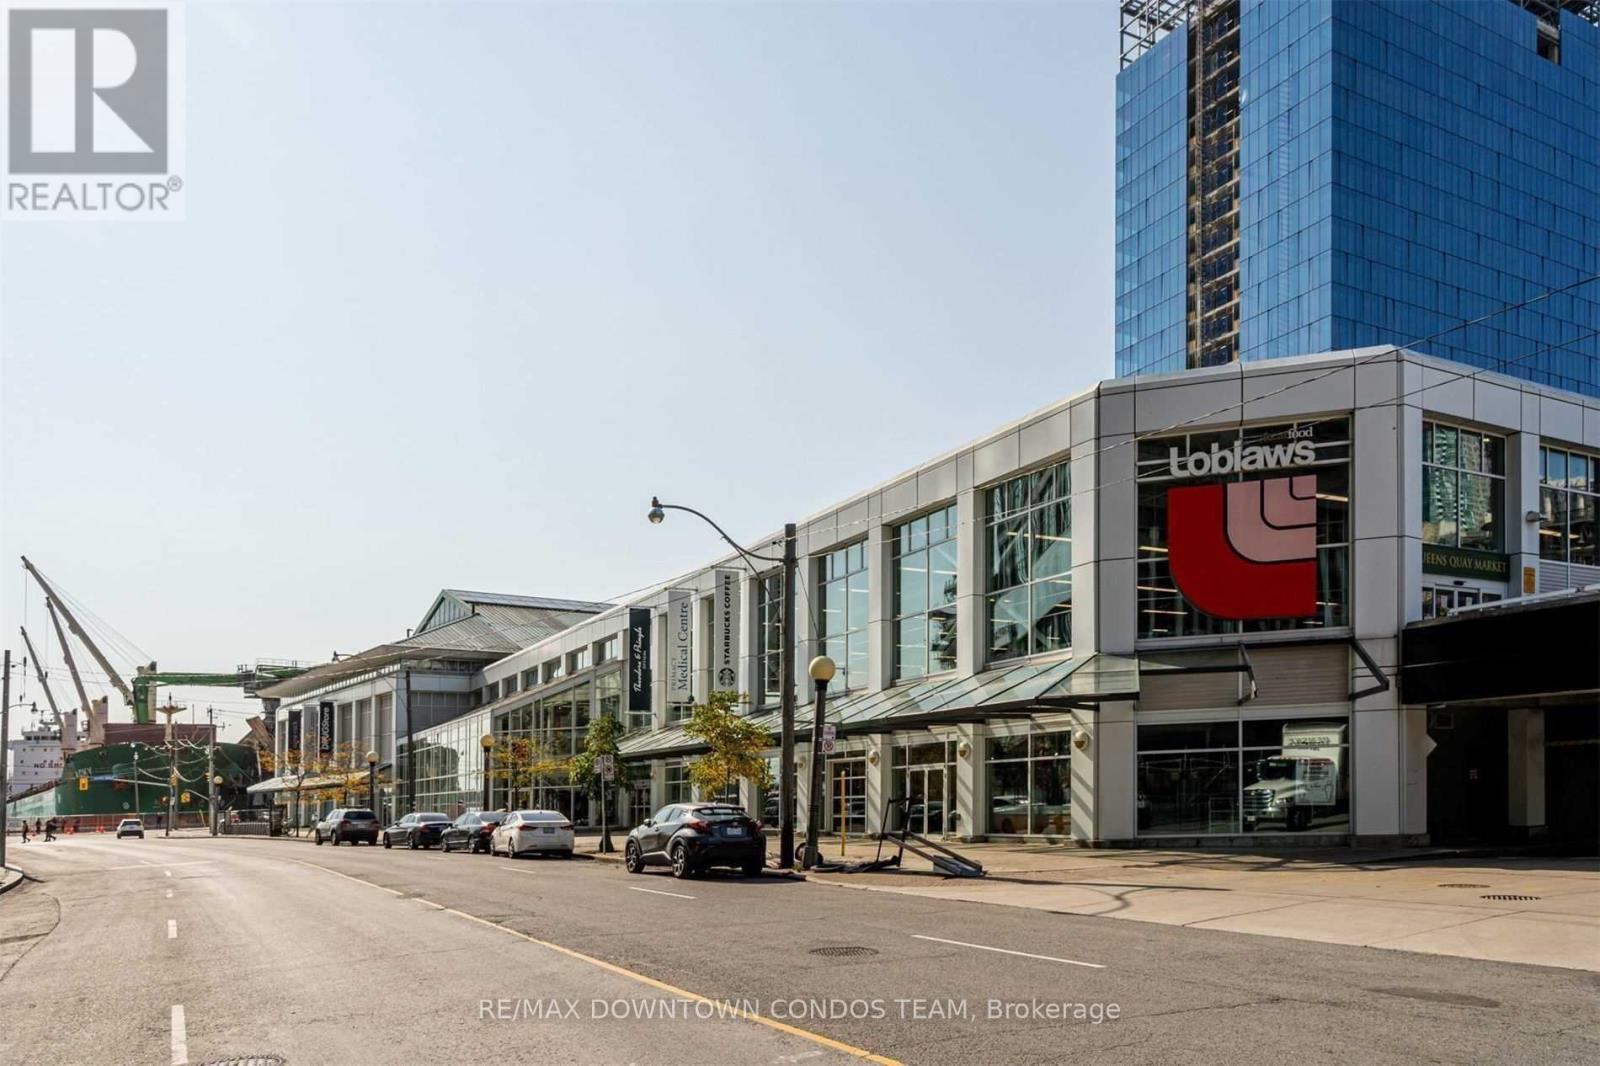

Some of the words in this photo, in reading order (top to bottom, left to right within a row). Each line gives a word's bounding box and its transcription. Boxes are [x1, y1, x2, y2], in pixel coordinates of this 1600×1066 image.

[1288, 426, 1313, 439] food
[1449, 554, 1473, 569] QUAY
[1474, 558, 1506, 573] MARKET
[723, 574, 731, 609] COFFEE
[677, 602, 689, 642] Centre
[723, 610, 731, 666] STARBUCKS
[633, 626, 645, 653] Pringle
[633, 661, 642, 693] Theodore
[677, 645, 688, 691] Medical
